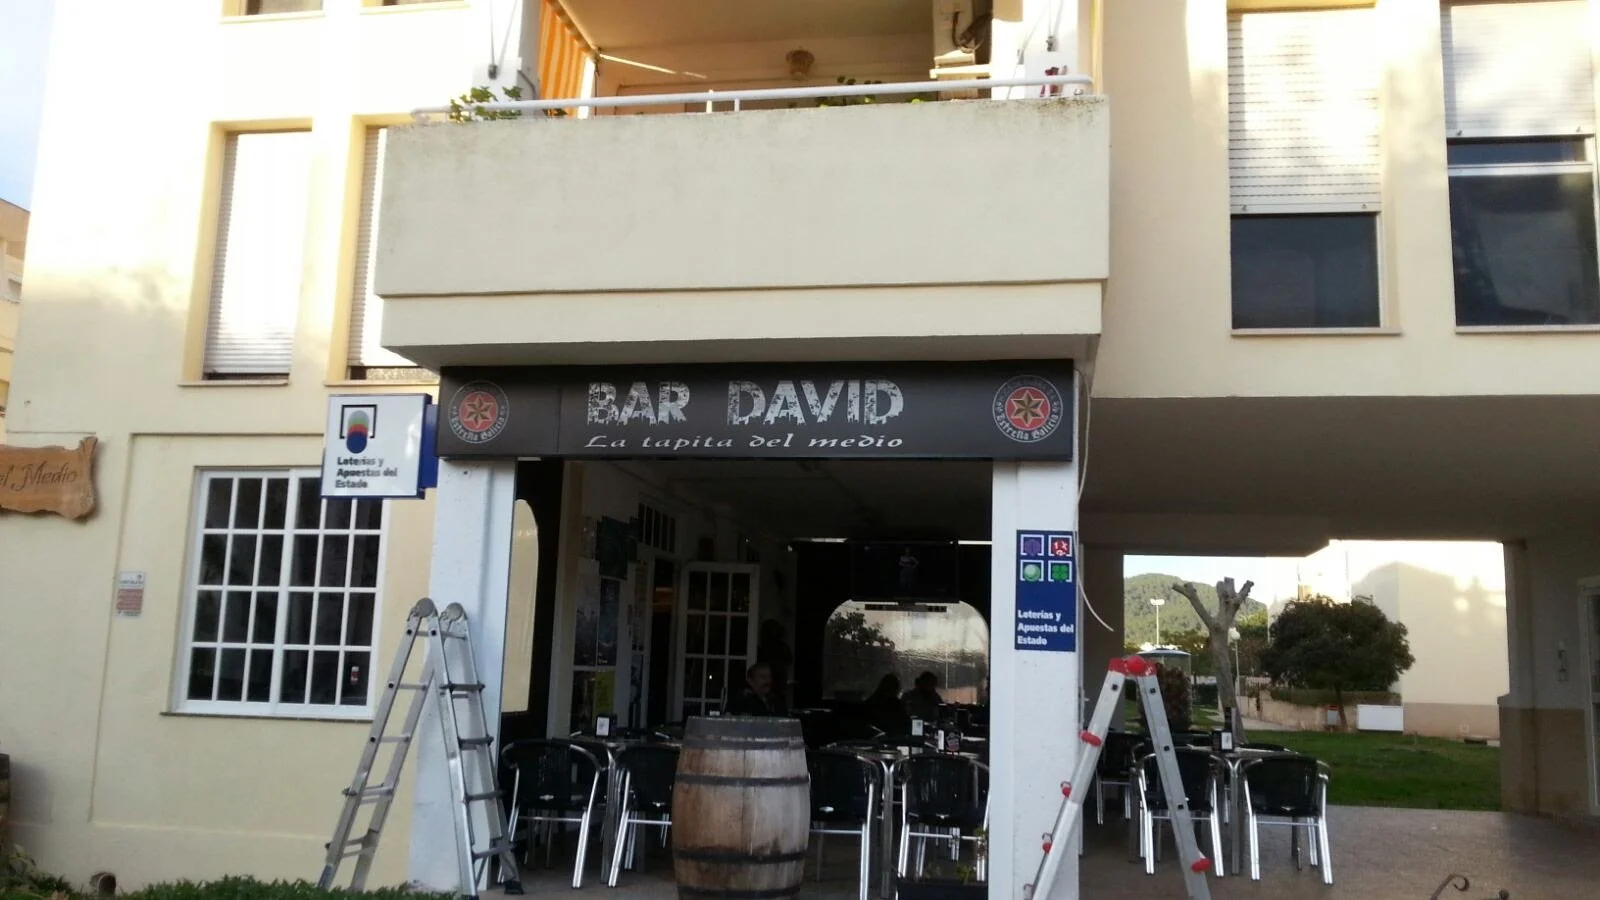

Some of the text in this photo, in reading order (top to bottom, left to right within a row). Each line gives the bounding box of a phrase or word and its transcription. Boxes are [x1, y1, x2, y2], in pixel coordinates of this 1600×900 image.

[587, 379, 904, 426] BAR DAVID
[584, 433, 904, 451] La tapita del medio
[378, 458, 384, 467] y
[11, 460, 77, 491] Medio
[336, 467, 397, 478] Apuestas del
[335, 479, 368, 489] Estado
[1055, 612, 1062, 622] y
[1017, 622, 1074, 633] Apuestas del
[1017, 635, 1048, 645] Estado
